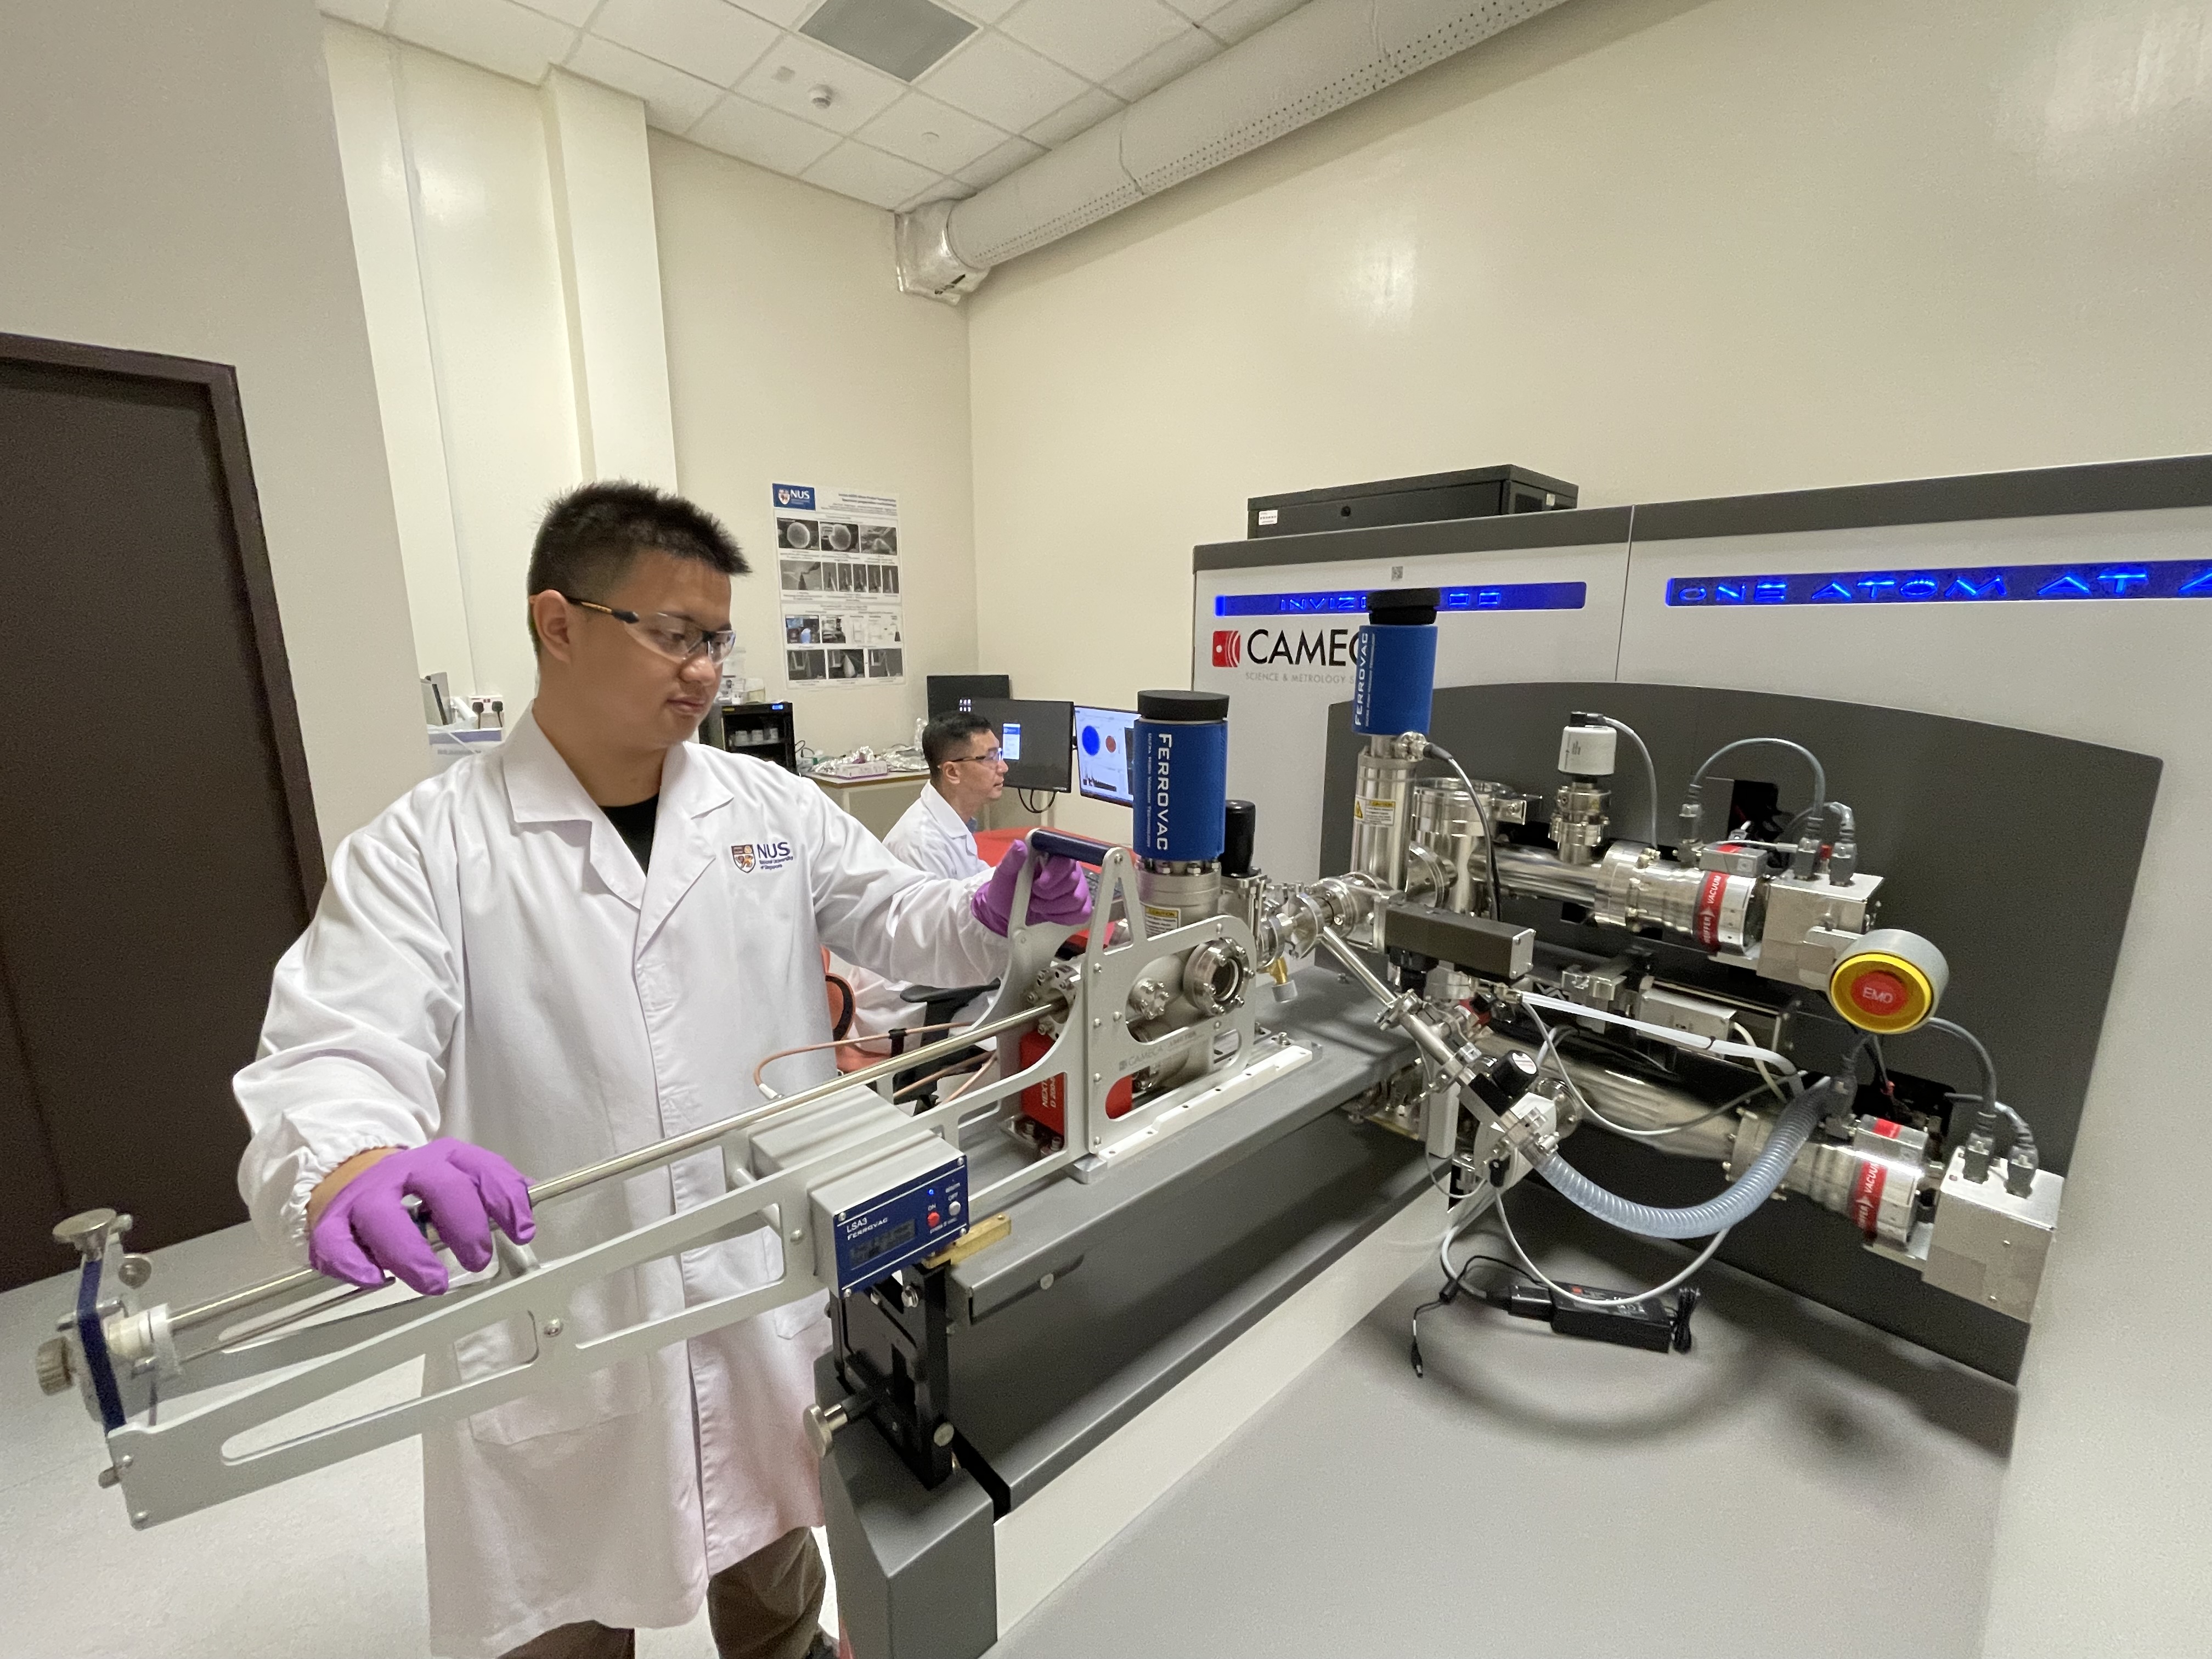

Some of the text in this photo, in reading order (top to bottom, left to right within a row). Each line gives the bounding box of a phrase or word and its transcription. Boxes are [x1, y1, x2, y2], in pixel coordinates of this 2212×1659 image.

[790, 489, 810, 500] NUS
[1679, 582, 1787, 601] ONE
[1811, 574, 2008, 601] ATOM
[2036, 569, 2148, 595] AT
[1246, 672, 1279, 681] SCIENCE
[1283, 673, 1288, 681] &
[1291, 673, 1346, 684] METROLOGY
[1355, 633, 1368, 726] FERROVAC
[1156, 733, 1172, 851] FERROVAC
[757, 842, 791, 859] NUS
[1707, 875, 1722, 905] VACUUM
[1863, 986, 1893, 1004] EMO
[846, 1217, 867, 1233] LSA3
[847, 1217, 888, 1240] FERROVAC
